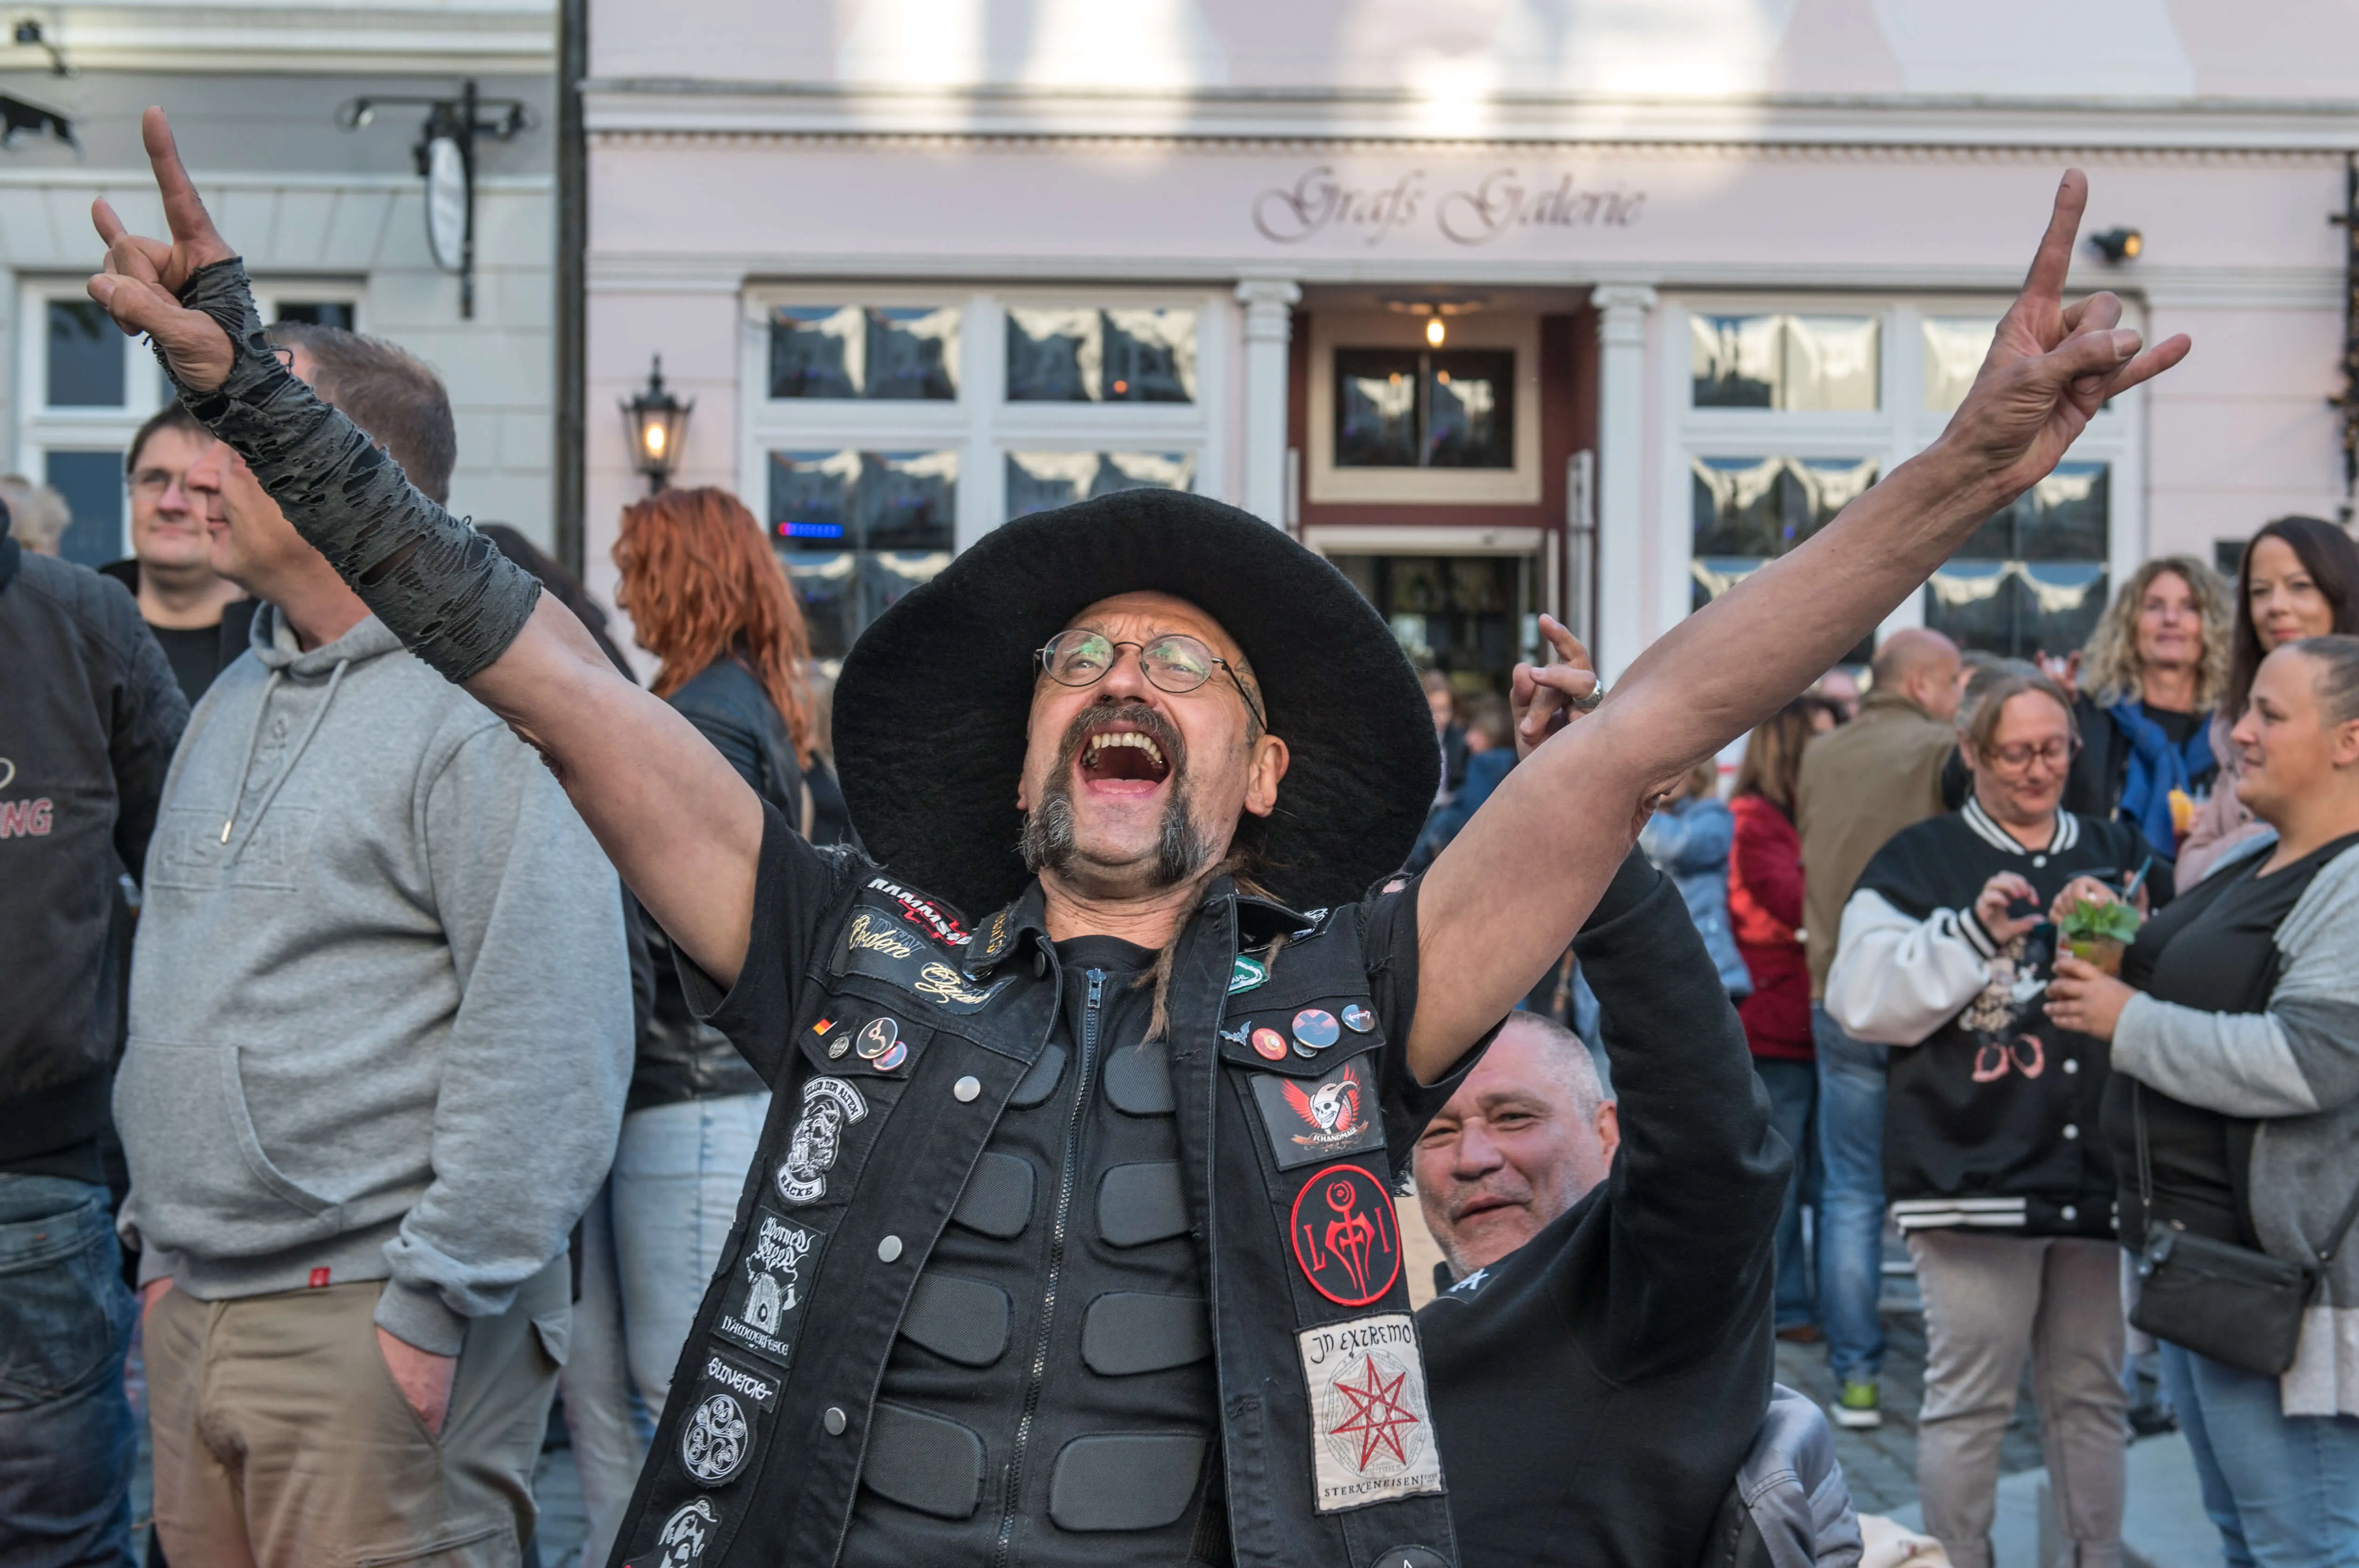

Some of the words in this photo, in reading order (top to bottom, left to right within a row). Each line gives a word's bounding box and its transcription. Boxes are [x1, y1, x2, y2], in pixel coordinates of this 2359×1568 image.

[1435, 167, 1647, 247] Galerie
[0, 798, 53, 838] NG
[824, 1081, 838, 1094] DER
[838, 1087, 858, 1116] ALTEN
[1312, 1126, 1359, 1142] SCHANDMAUL
[1340, 1324, 1412, 1358] EXTREMO
[1325, 1475, 1419, 1497] STERNENEISEN
